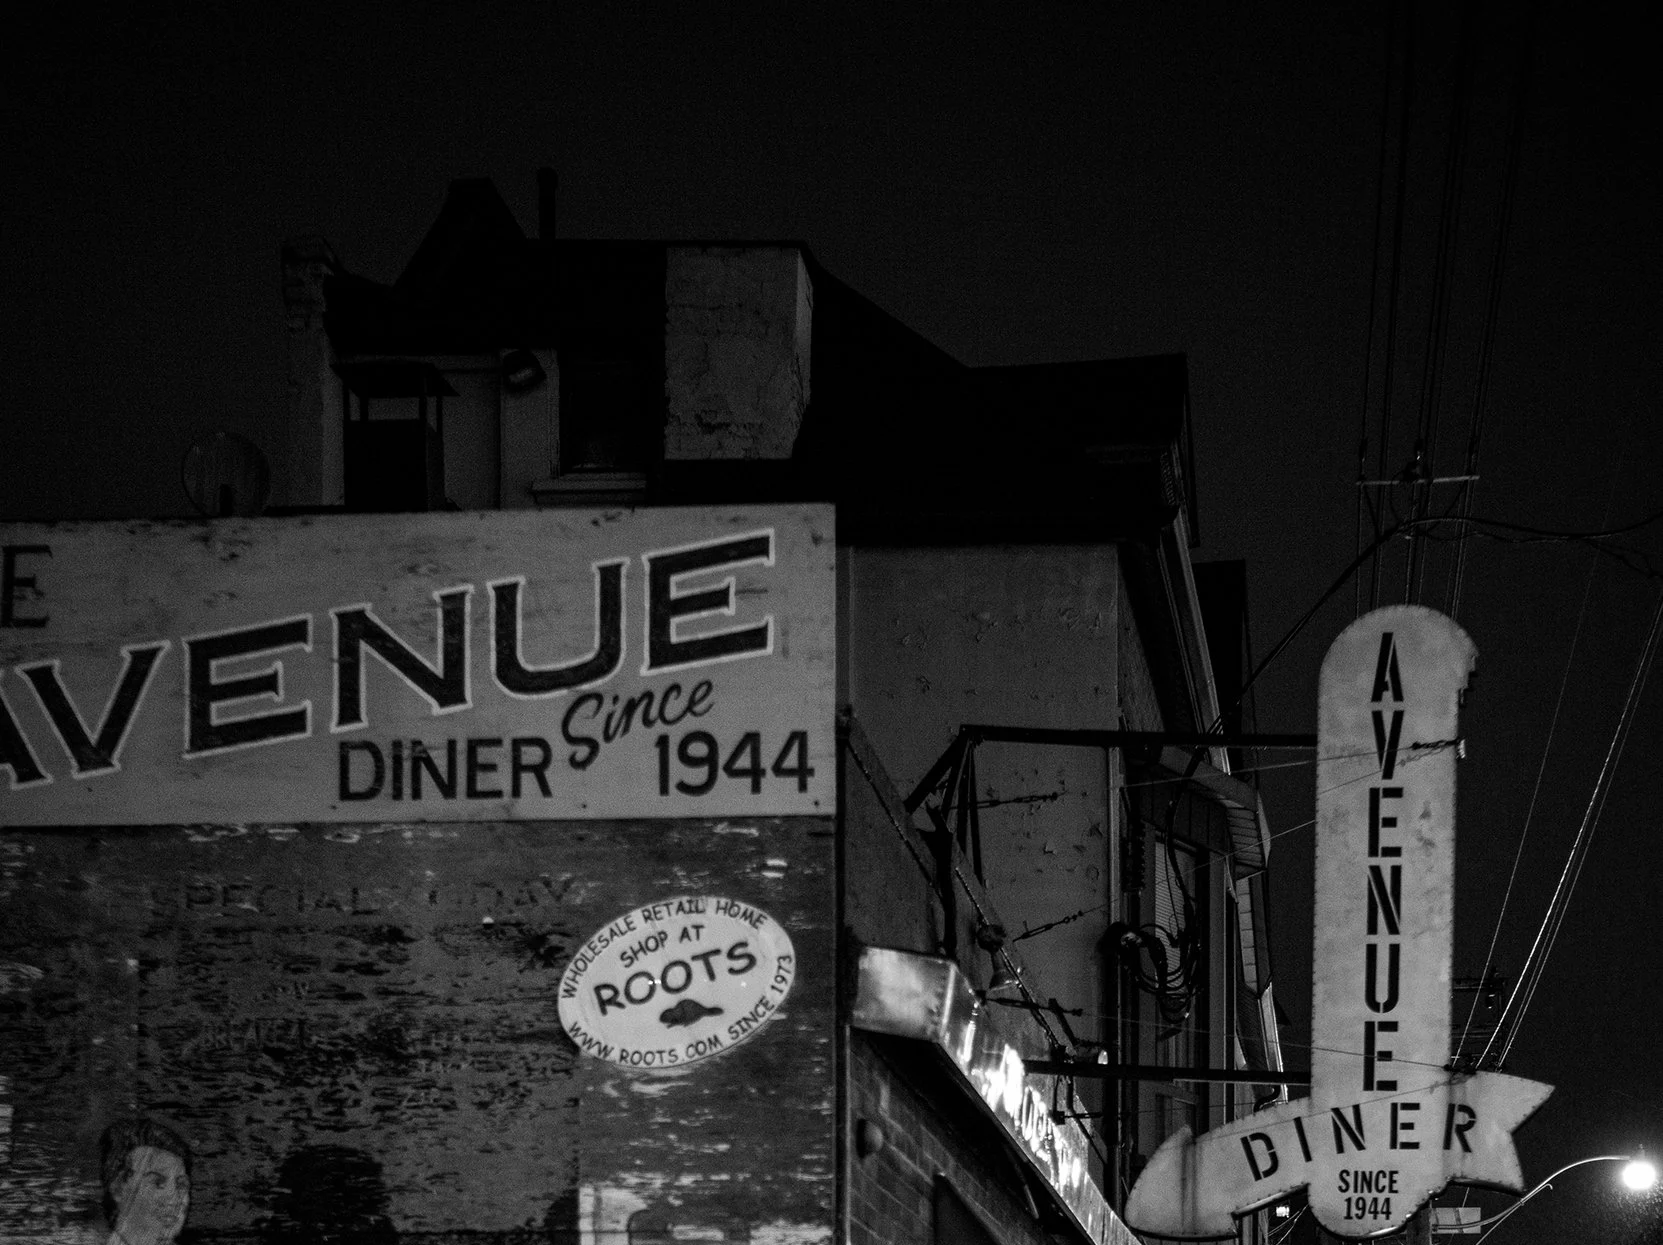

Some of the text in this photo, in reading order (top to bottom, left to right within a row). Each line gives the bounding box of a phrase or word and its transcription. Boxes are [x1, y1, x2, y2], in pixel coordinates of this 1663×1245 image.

[339, 680, 815, 801] DINER Since 1944
[1363, 631, 1404, 1092] AVENUE
[562, 899, 768, 999] WHOLESALE RETAIL HOME
[594, 942, 757, 1016] ROOTS
[620, 925, 705, 968] SHOP AT
[728, 996, 775, 1041] SINCE
[771, 955, 793, 995] 1973
[1240, 1102, 1477, 1182] DINER
[1338, 1169, 1399, 1194] SINCE
[1344, 1197, 1392, 1220] 1944
